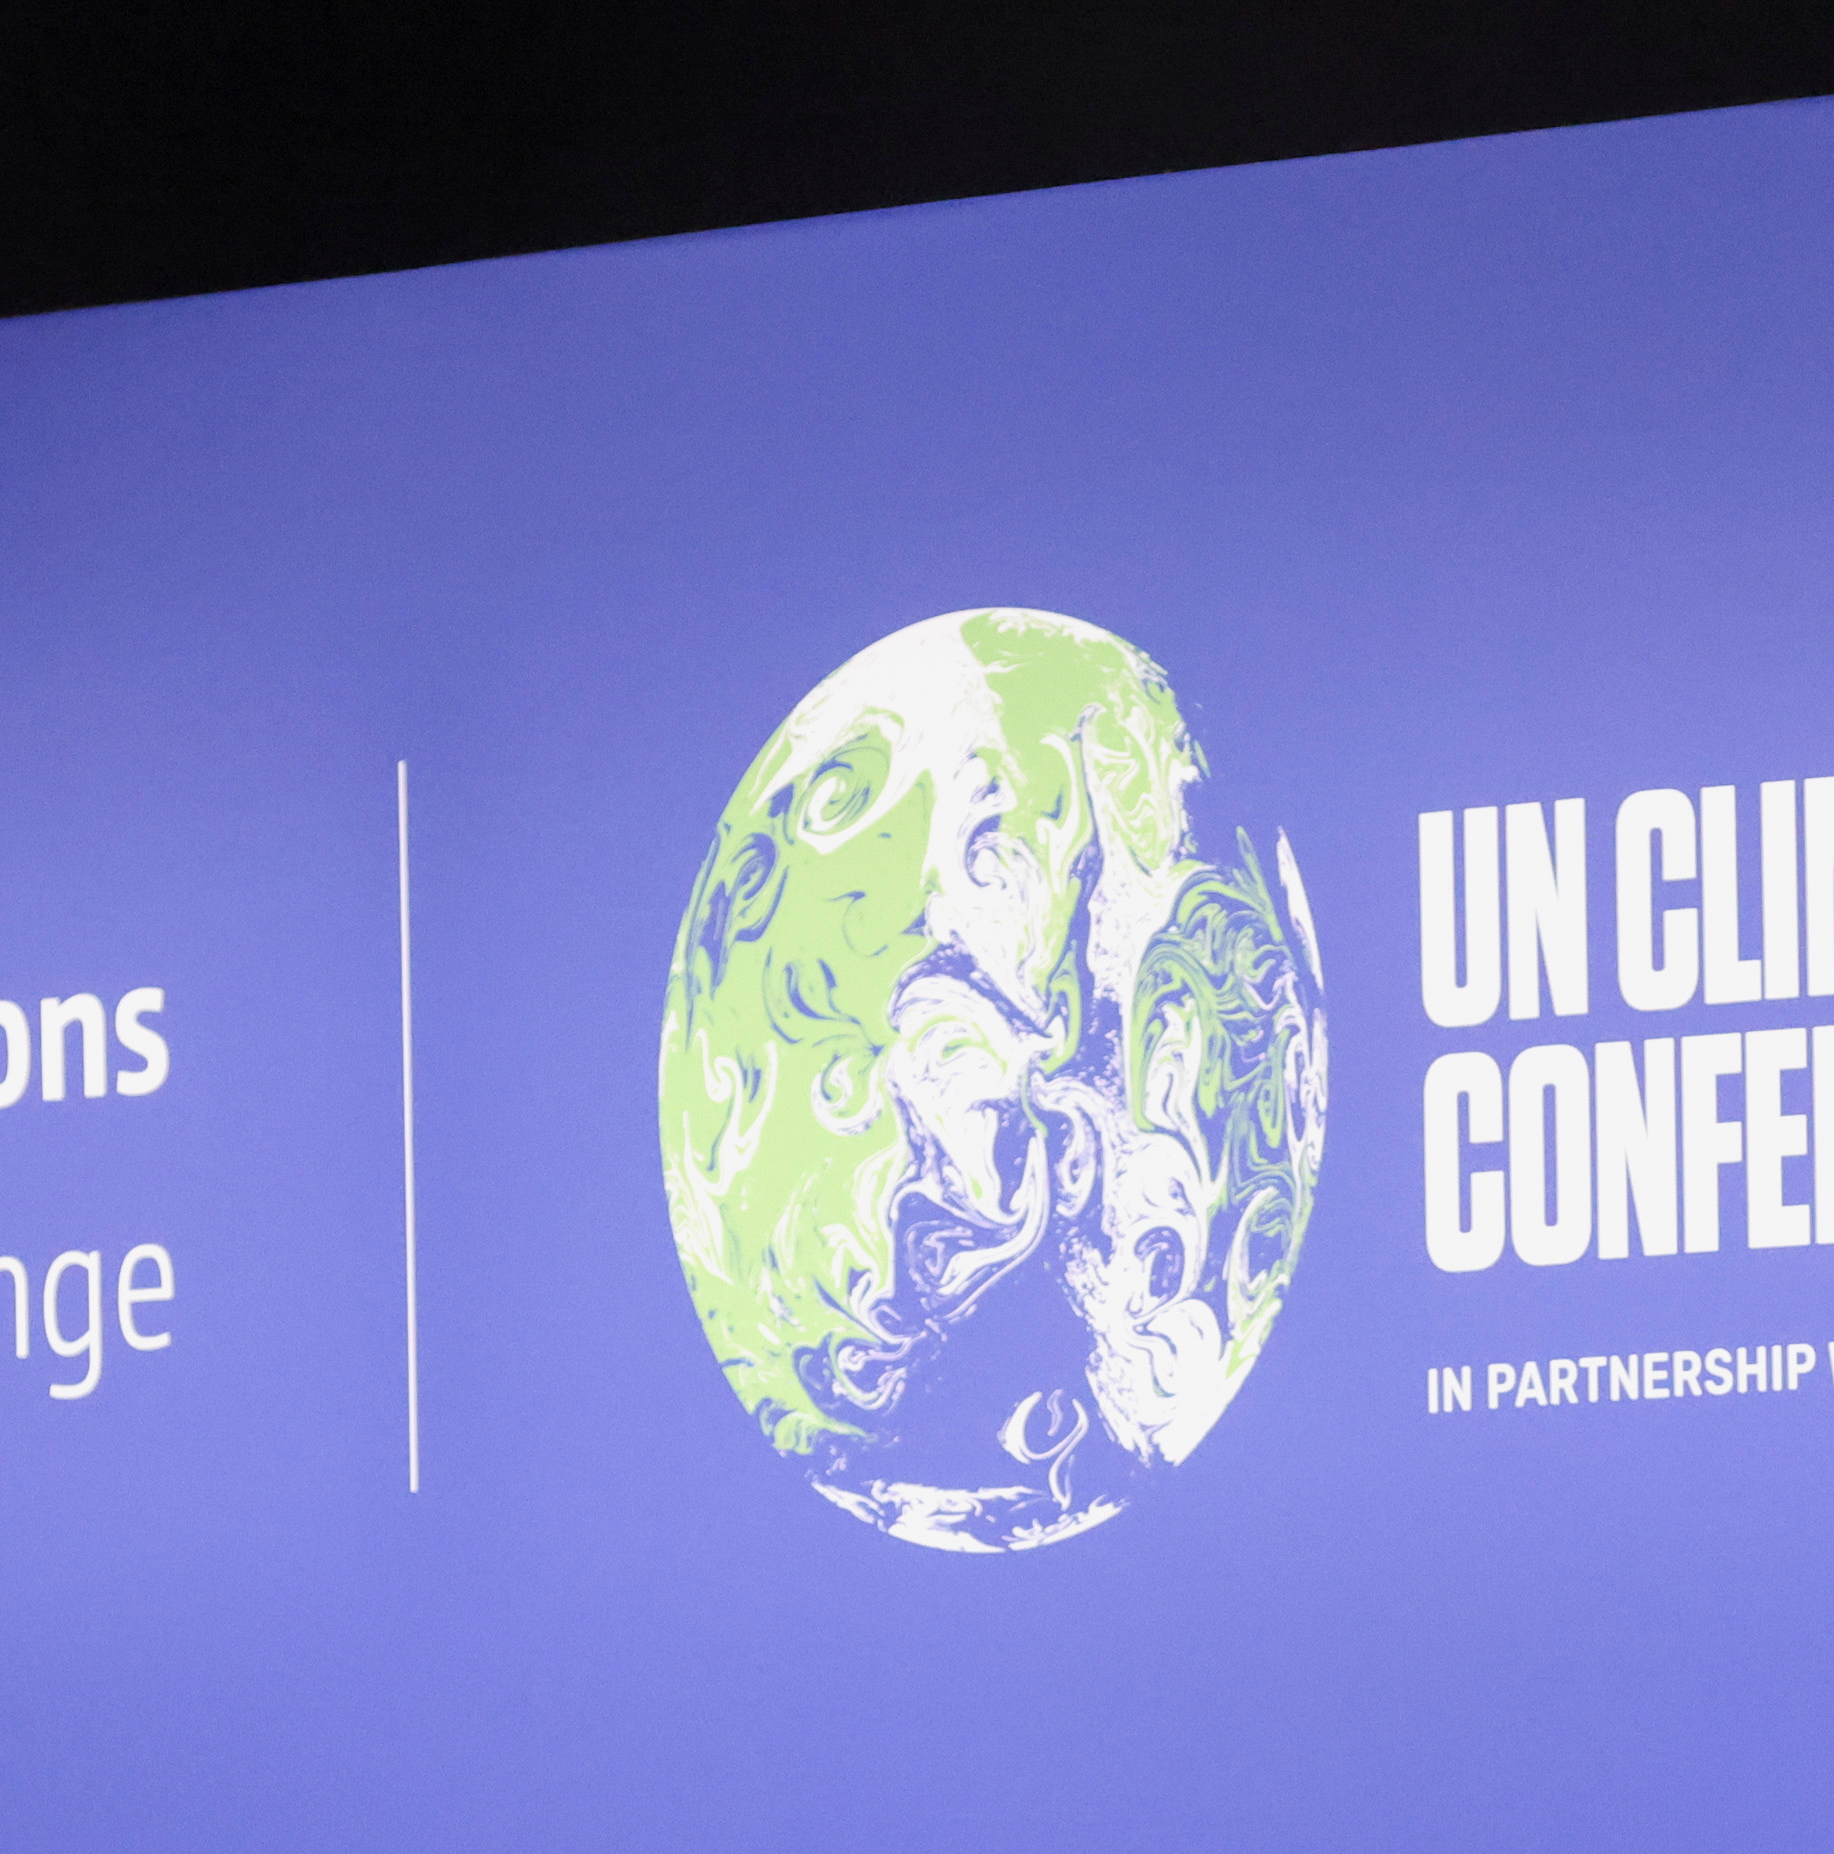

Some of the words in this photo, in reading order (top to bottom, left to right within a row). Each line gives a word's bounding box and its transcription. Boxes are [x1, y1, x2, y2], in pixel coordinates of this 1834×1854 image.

[1418, 797, 1587, 1029] UN
[1427, 1365, 1472, 1414] IN
[1487, 1343, 1817, 1410] PARTNERSHIP
